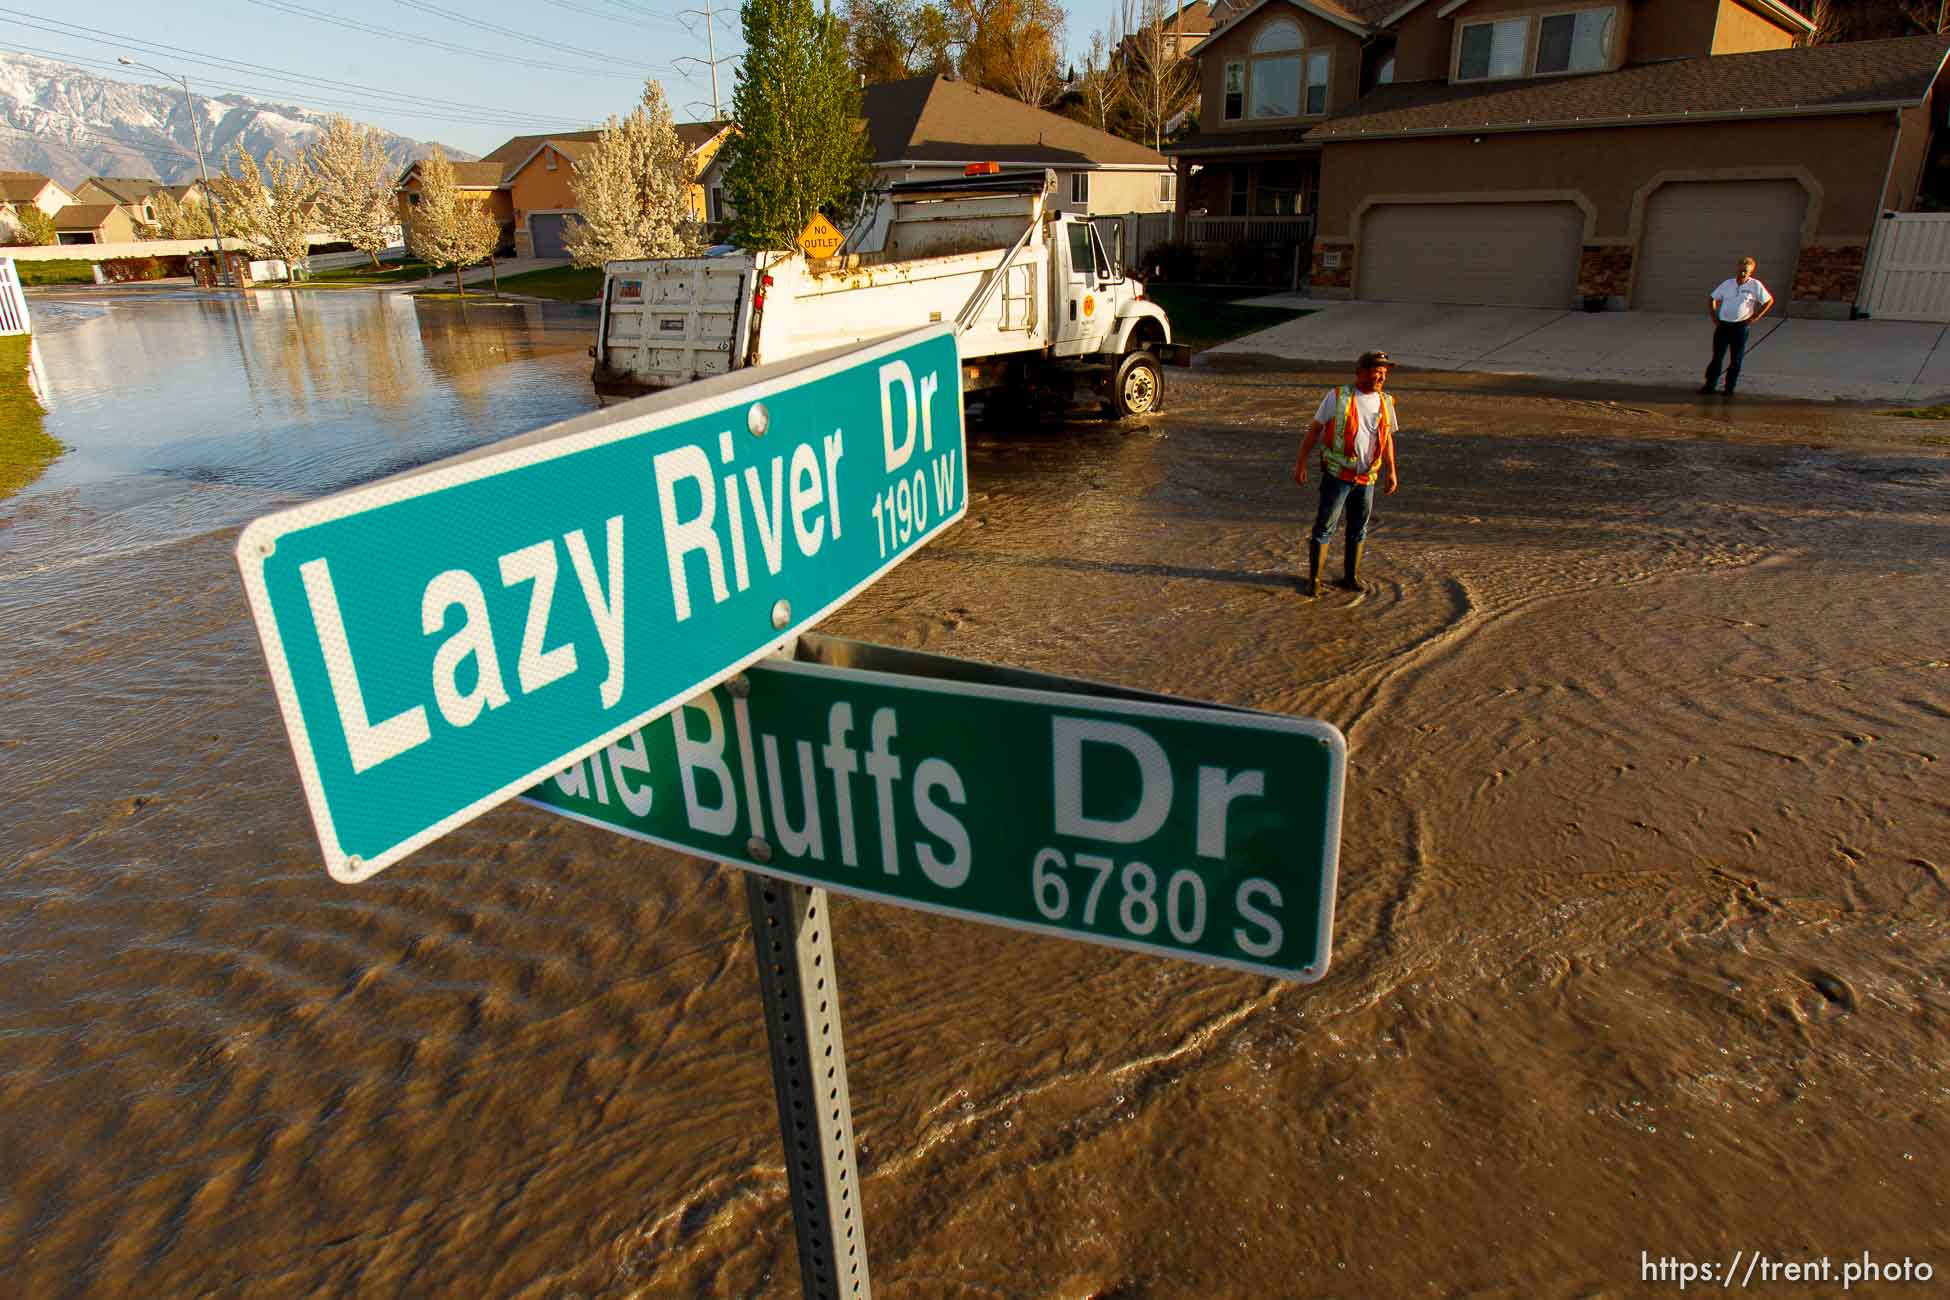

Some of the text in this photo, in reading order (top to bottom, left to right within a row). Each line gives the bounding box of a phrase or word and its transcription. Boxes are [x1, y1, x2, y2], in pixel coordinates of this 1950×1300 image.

[805, 238, 838, 249] OUTLET
[815, 225, 827, 235] NO
[871, 449, 955, 559] 1190 W
[300, 513, 625, 775] Lazy
[653, 428, 844, 623] River
[879, 359, 938, 474] Dr
[671, 700, 971, 889] Bluffs
[1050, 714, 1265, 860] Dr
[1032, 846, 1284, 957] 6780 S
